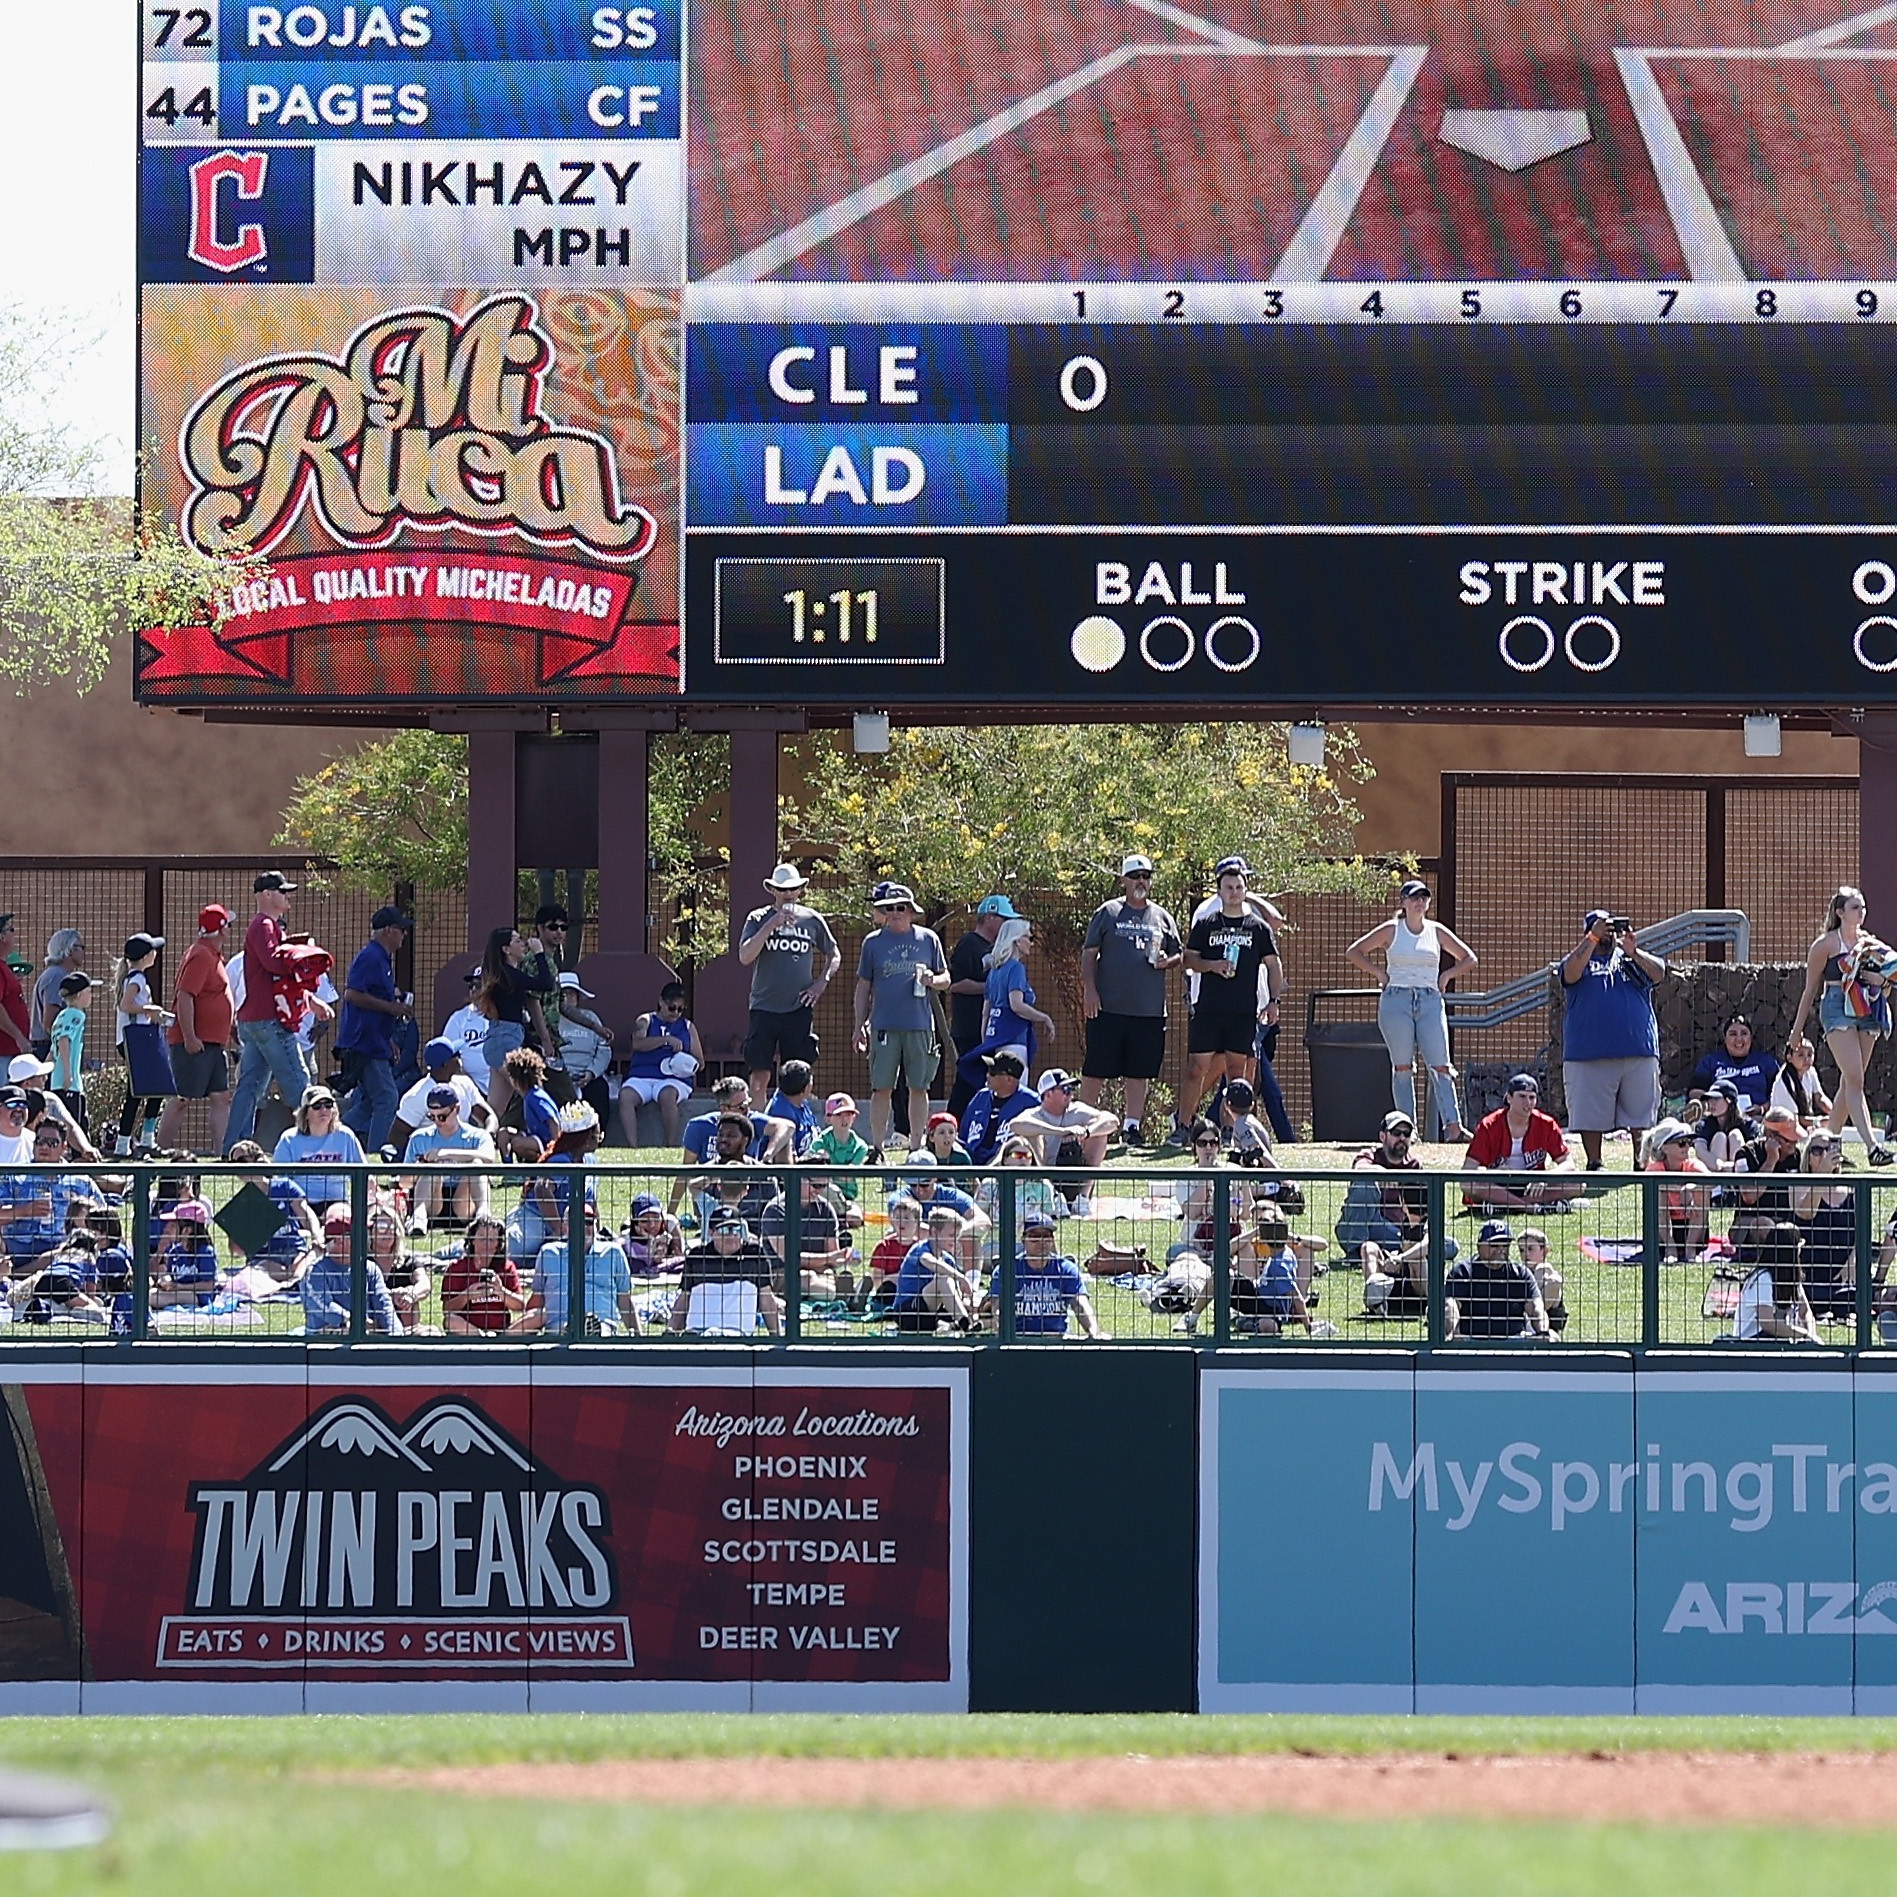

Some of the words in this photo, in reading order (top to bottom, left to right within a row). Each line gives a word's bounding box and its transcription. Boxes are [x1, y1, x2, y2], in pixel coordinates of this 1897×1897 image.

[152, 9, 213, 49] 72
[247, 4, 431, 47] ROJAS
[590, 6, 658, 49] SS
[146, 86, 216, 126] 44
[247, 83, 429, 127] PAGES
[587, 83, 662, 128] CF
[352, 162, 642, 207] NIKHAZY
[188, 149, 270, 273] C
[513, 227, 631, 267] MPH
[1073, 290, 1087, 318] 1
[1163, 290, 1185, 318] 2
[1263, 290, 1285, 318] 3
[1360, 290, 1385, 318] 4
[1461, 290, 1482, 318] 5
[1559, 290, 1583, 318] 6
[1657, 290, 1680, 318] 7
[1755, 290, 1778, 318] 8
[1855, 290, 1878, 318] 9
[347, 294, 554, 440] Mi
[768, 345, 919, 404] CLE
[1060, 355, 1108, 413] 0
[180, 351, 657, 564] Ruca
[764, 445, 926, 506] LAD
[312, 566, 430, 604] QUALITY
[436, 566, 613, 619] MICHELADAS
[1095, 561, 1247, 606] BALL
[1458, 560, 1666, 606] STRIKE
[784, 589, 878, 644] 1:11
[765, 939, 810, 953] WOOD
[1209, 934, 1253, 948] CHAMPIONS
[675, 1406, 786, 1448] Arizona
[792, 1406, 920, 1437] Locations
[735, 1456, 867, 1479] PHOENIX
[721, 1498, 879, 1521] GLENDALE
[195, 1490, 377, 1608] TWIN
[397, 1490, 611, 1608] PEAKS
[704, 1540, 897, 1564] SCOTTSDALE
[746, 1583, 846, 1606] TEMPE
[177, 1629, 243, 1653] EATS
[284, 1629, 385, 1654] DRINKS
[424, 1630, 521, 1653] SCENIC
[526, 1629, 616, 1654] VIEWS
[700, 1626, 778, 1649] DEER
[788, 1626, 900, 1650] VALLEY
